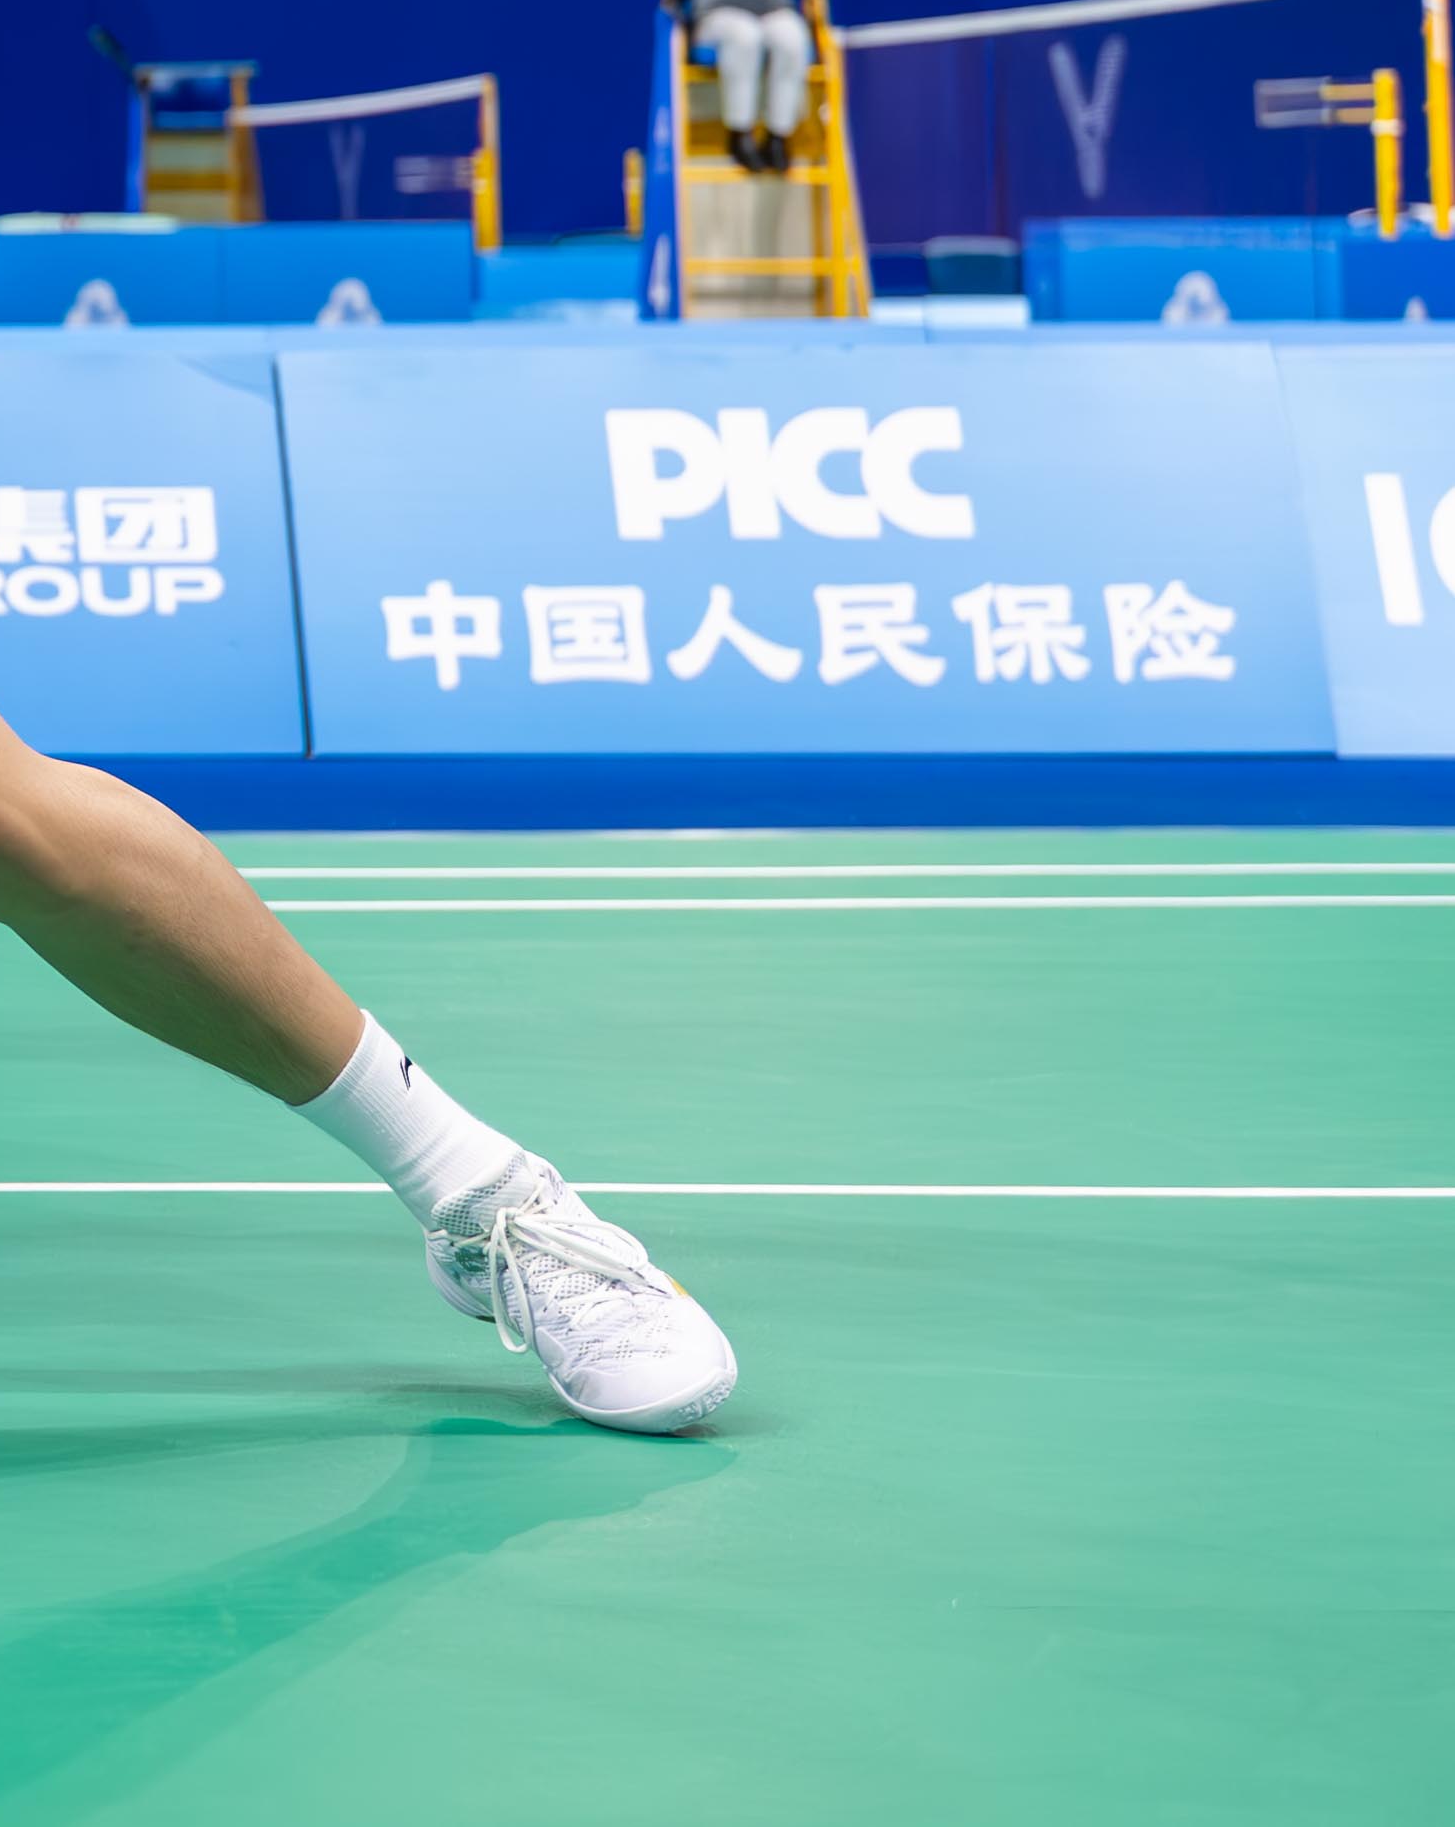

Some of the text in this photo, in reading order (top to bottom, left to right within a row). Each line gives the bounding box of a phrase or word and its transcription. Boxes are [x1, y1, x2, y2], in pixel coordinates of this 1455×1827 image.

[604, 406, 976, 540] PICC
[1364, 472, 1455, 626] I
[379, 578, 1238, 691] 中国人民保险
